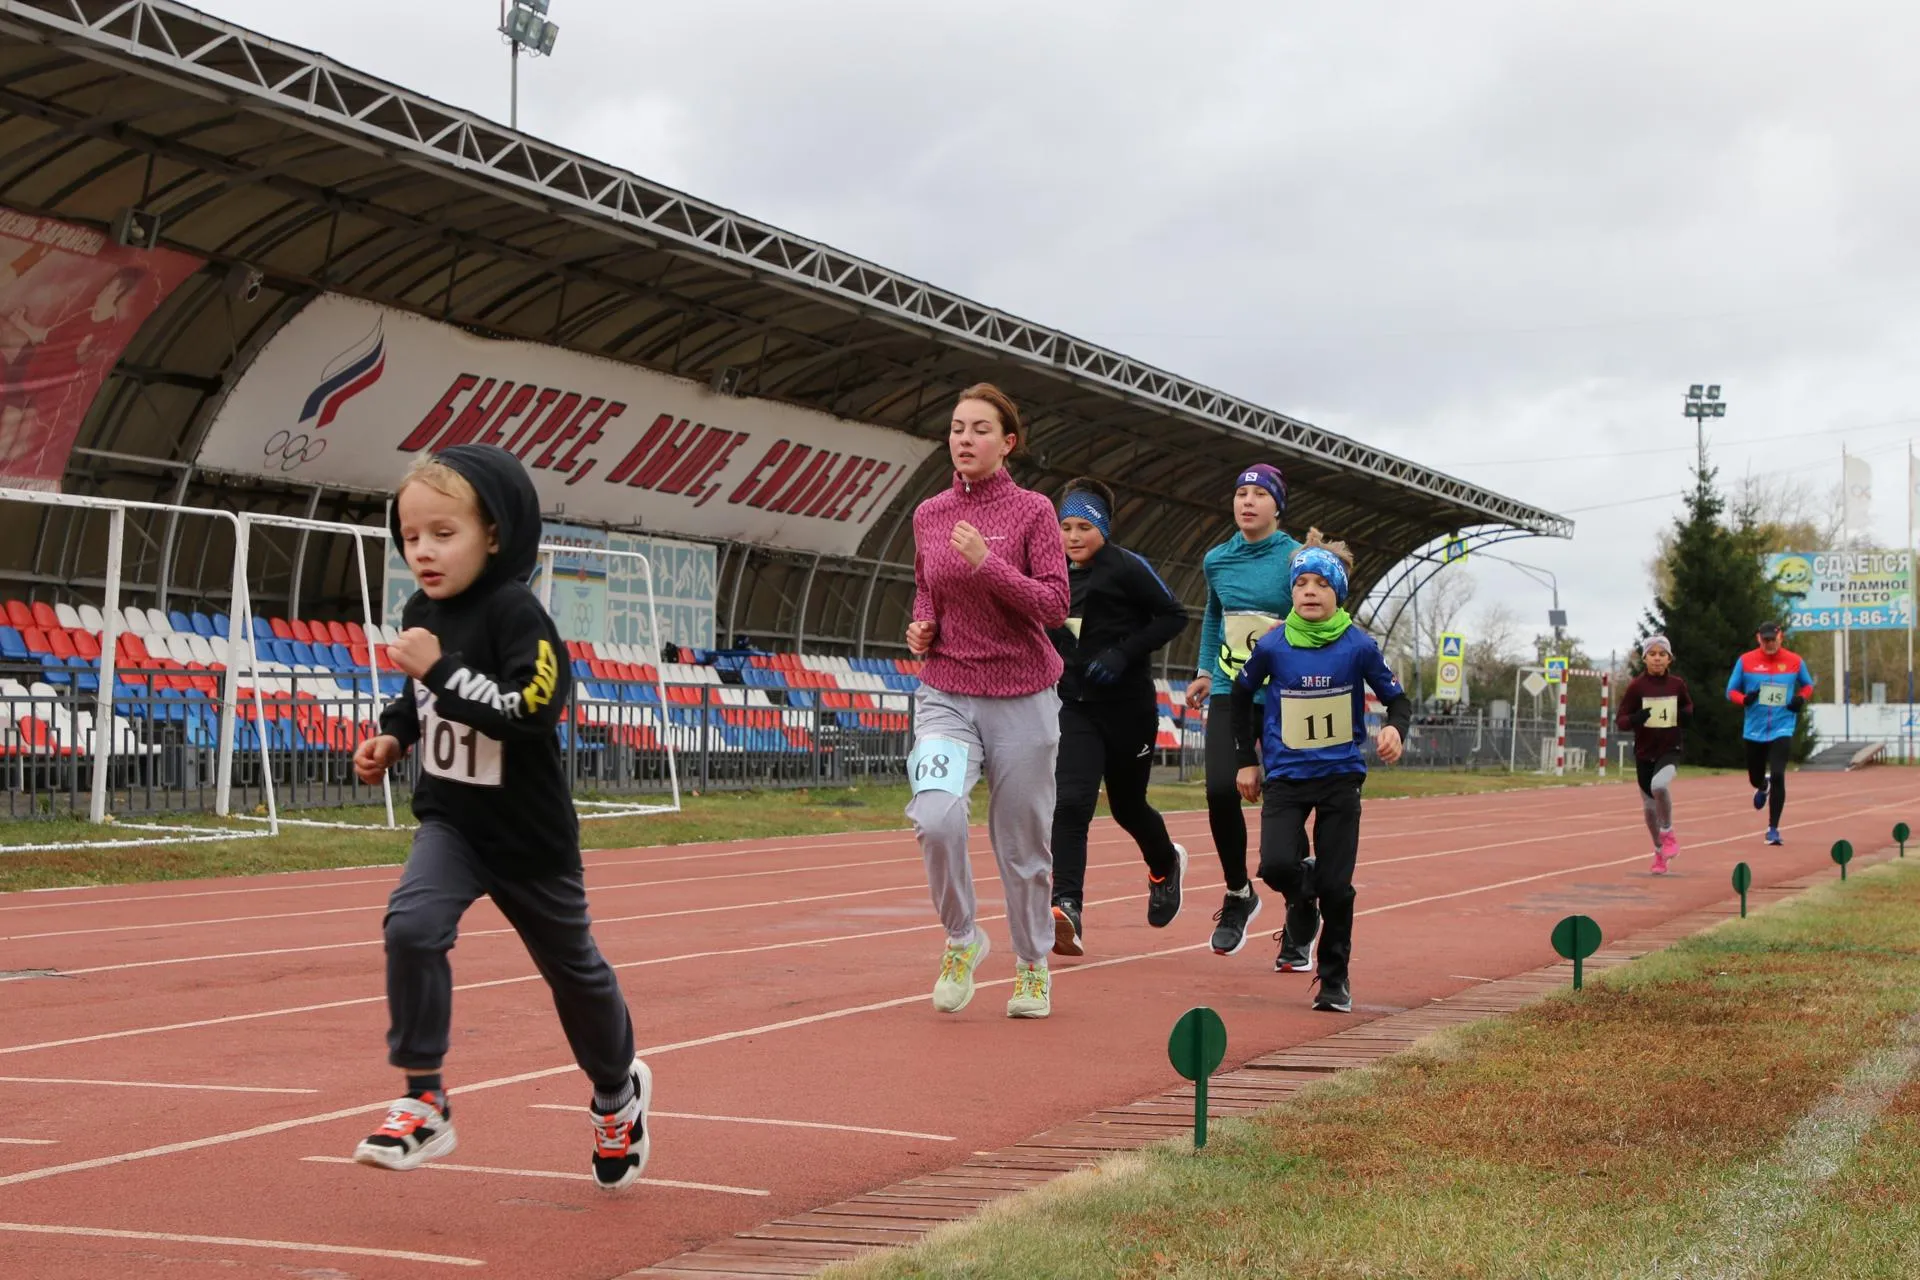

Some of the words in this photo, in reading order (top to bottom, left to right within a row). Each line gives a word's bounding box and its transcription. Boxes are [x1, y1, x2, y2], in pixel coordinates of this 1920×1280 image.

[397, 373, 627, 485] БЫСТРЕЕ,
[605, 413, 750, 508] ВЫШЕ,
[1813, 553, 1910, 577] СДАЕТСЯ
[1821, 579, 1909, 592] РЕКЛАМНОЕ
[1840, 593, 1891, 603] МЕСТО
[1786, 610, 1910, 627] 26-618-86-72
[1767, 692, 1783, 703] 45
[1659, 708, 1667, 722] 4
[1303, 713, 1336, 741] 11
[419, 714, 477, 777] 101
[915, 753, 949, 781] 68
